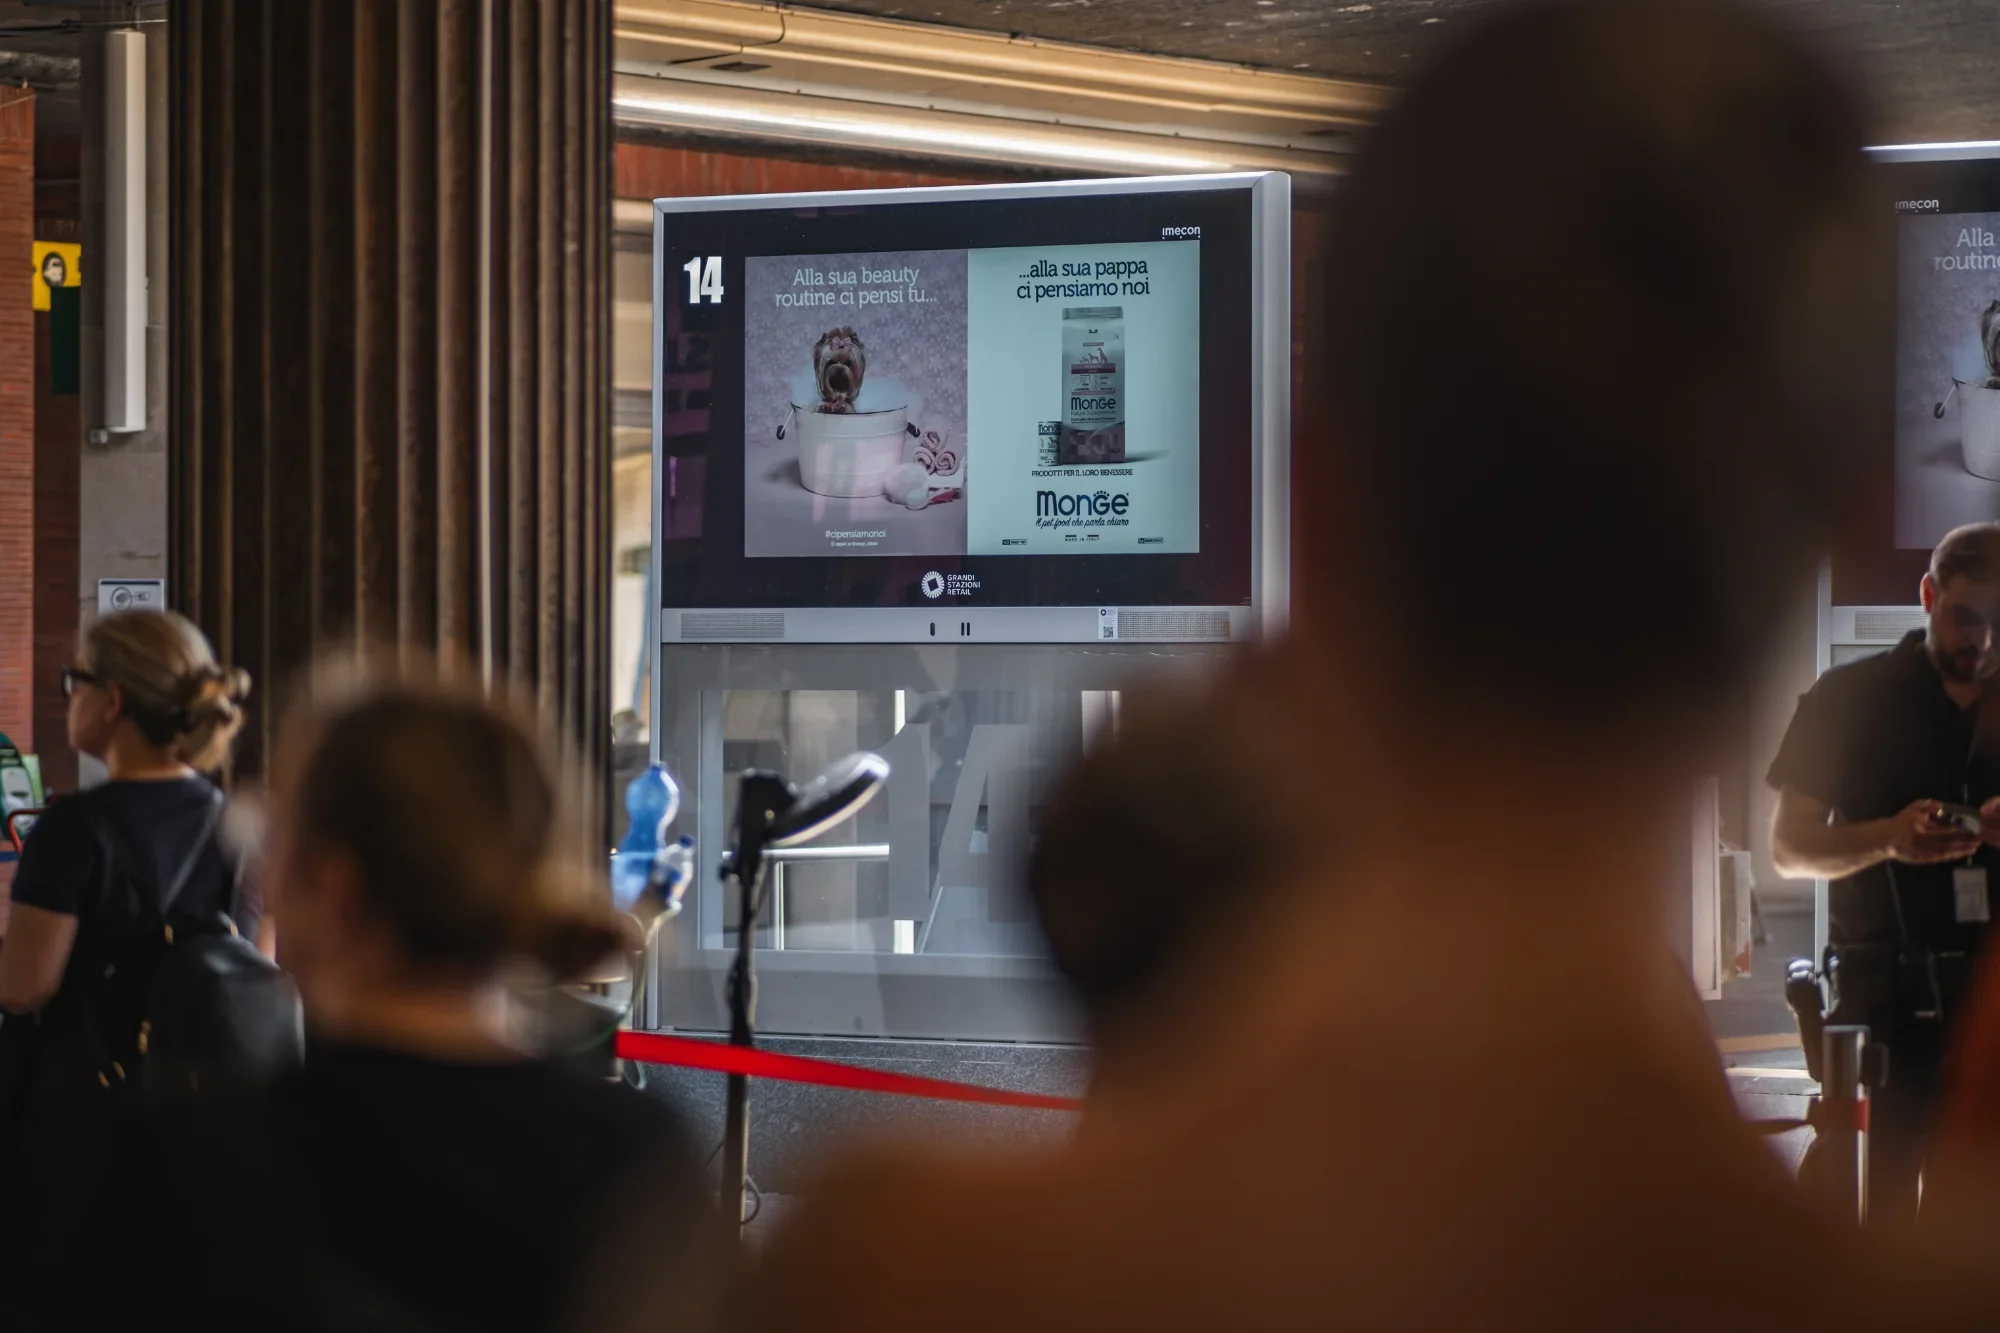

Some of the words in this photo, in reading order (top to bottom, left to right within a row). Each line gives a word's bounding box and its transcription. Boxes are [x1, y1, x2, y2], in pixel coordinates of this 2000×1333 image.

[1162, 226, 1201, 239] imecon
[1956, 227, 1995, 247] Alla
[1019, 260, 1058, 278] ...alla
[1062, 263, 1091, 277] sua
[1095, 260, 1148, 279] pappa
[1934, 250, 2000, 271] routin
[683, 256, 724, 303] 14
[793, 268, 824, 286] Alla
[828, 271, 857, 285] sua
[861, 266, 920, 287] beauty
[775, 289, 836, 307] routine
[840, 288, 855, 305] ci
[858, 286, 904, 309] pensi
[908, 286, 937, 303] tu...
[1017, 281, 1031, 299] ci
[1034, 279, 1118, 303] pensiamo
[1122, 277, 1150, 296] noi
[1063, 469, 1075, 477] PER
[1041, 518, 1054, 529] pet
[1053, 517, 1071, 530] food
[1072, 517, 1084, 527] che
[1084, 517, 1105, 528] parla
[1106, 516, 1129, 526] chiaro
[825, 529, 886, 539] #cipensiamonoi
[947, 588, 972, 596] RETAIL
